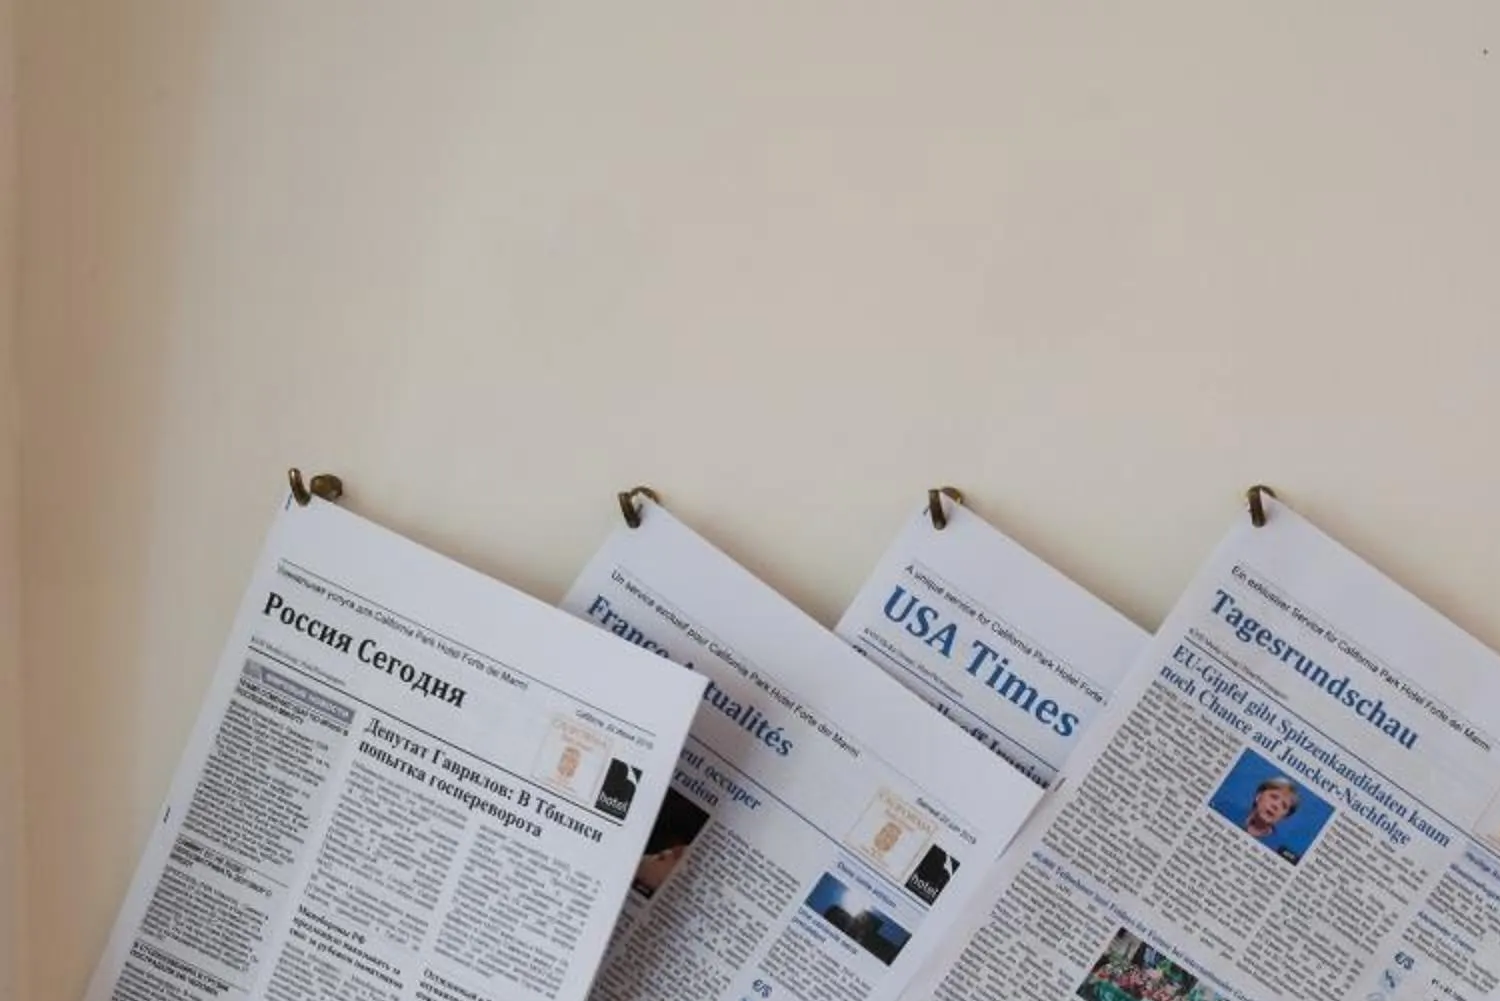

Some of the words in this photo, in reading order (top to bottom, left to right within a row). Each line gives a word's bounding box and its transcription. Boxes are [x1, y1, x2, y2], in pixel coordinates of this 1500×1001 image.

[262, 591, 353, 653] Россия
[357, 638, 466, 708] Сегодня
[373, 611, 414, 636] California
[414, 629, 435, 647] Park
[436, 641, 460, 658] Hotel
[461, 652, 485, 670] Forte
[624, 581, 655, 606] service
[655, 604, 689, 630] exclusif
[685, 628, 709, 645] pour
[708, 642, 749, 677] California
[748, 671, 770, 692] Park
[768, 687, 795, 709] Hotel
[793, 703, 817, 726] Forte
[883, 584, 957, 658] USA
[965, 639, 1079, 736] Times
[913, 571, 944, 594] unique
[943, 591, 976, 617] service
[991, 621, 1032, 655] California
[1032, 649, 1054, 669] Park
[1054, 664, 1080, 686] Hotel
[1079, 681, 1103, 702] Forte
[1211, 589, 1418, 750] Tagesrundschau
[1231, 565, 1246, 580] Ein
[1247, 578, 1291, 611] exklusiver
[1291, 607, 1324, 635] Service
[1337, 639, 1379, 672] California
[1379, 668, 1400, 688] Park
[1399, 683, 1425, 704] Hotel
[1423, 700, 1448, 722] Forte
[683, 659, 793, 757] tualités
[1159, 665, 1196, 696] noch
[1198, 688, 1252, 734] Chance
[1251, 731, 1281, 752] auf
[1276, 745, 1410, 844] Juncker-Nachfolge
[1172, 644, 1248, 704] EU-Gipfel
[1243, 700, 1277, 726] gibt
[1276, 719, 1407, 818] Spitzenkandidaten
[1407, 809, 1450, 847] kaum
[358, 740, 426, 782] попытка
[428, 774, 542, 837] госпереворота
[363, 717, 428, 759] Депутат
[431, 748, 514, 800] Гаврилов:
[535, 796, 603, 842] Тбилиси
[598, 791, 628, 812] hotel
[673, 767, 718, 806] ration
[699, 762, 760, 809] occuper
[908, 872, 939, 898] hotel
